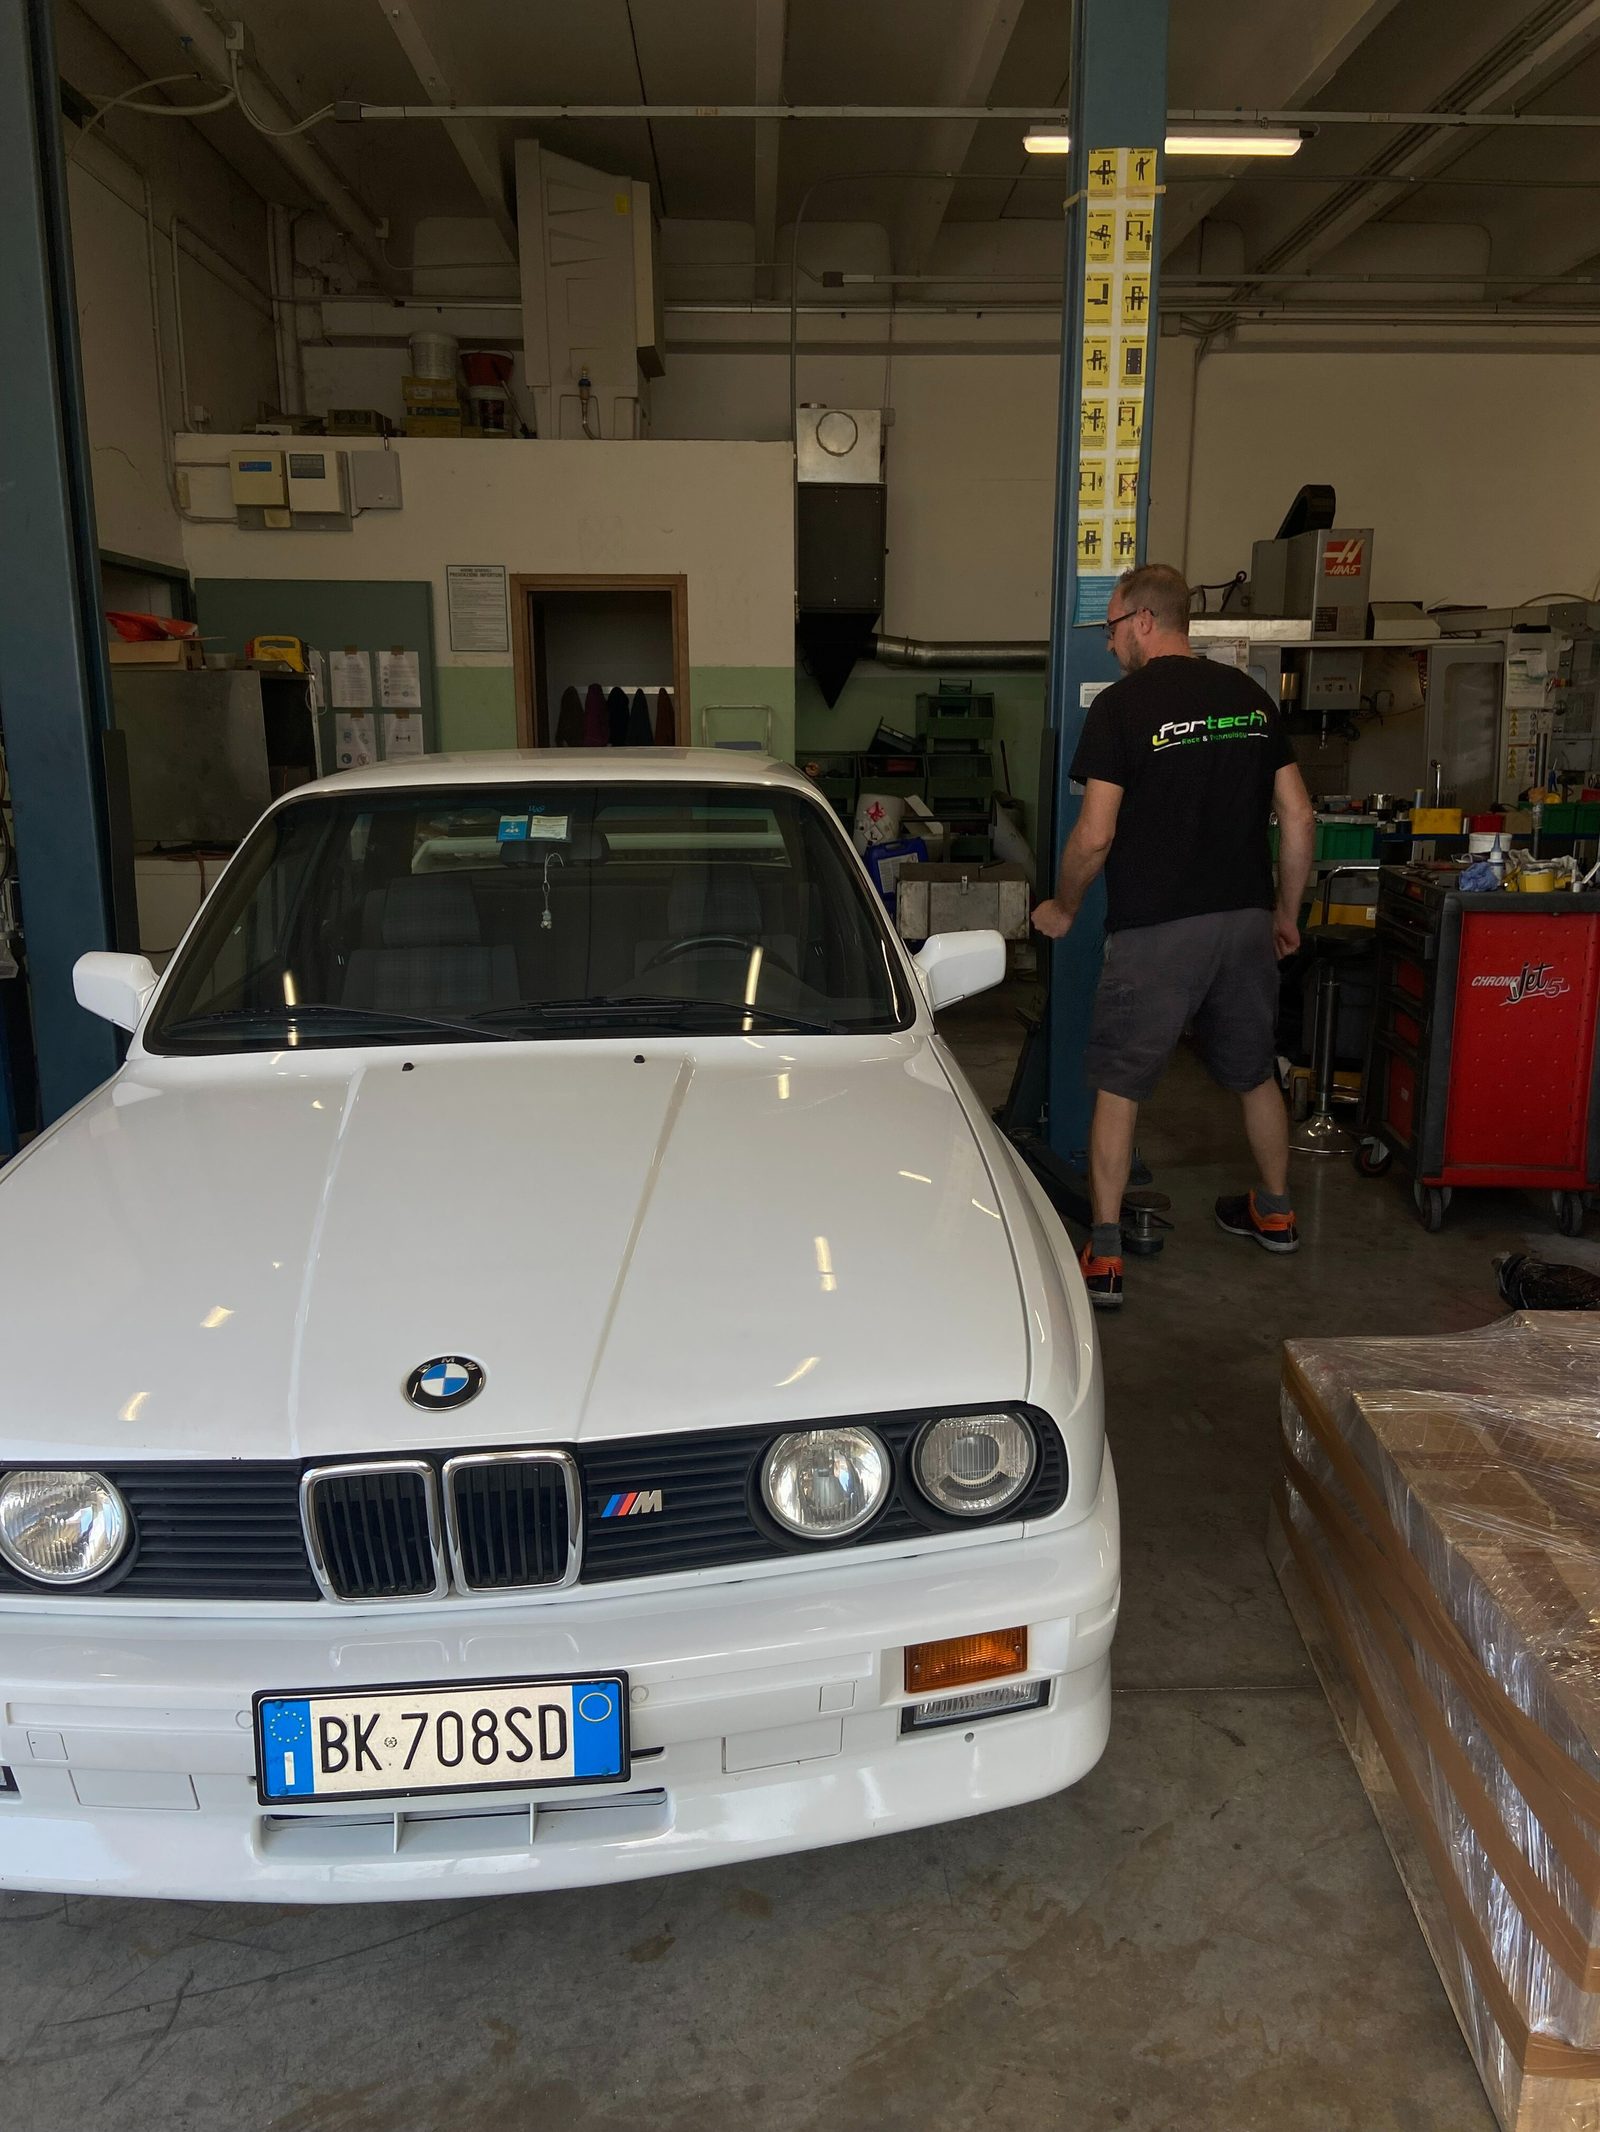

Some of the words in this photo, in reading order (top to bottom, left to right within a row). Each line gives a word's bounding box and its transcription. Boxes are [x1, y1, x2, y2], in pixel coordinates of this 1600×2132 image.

[1325, 564, 1361, 576] HAAS
[1158, 712, 1263, 739] fortech
[417, 1357, 479, 1374] BMW
[319, 1712, 382, 1773] BK
[401, 1704, 567, 1771] 708SD
